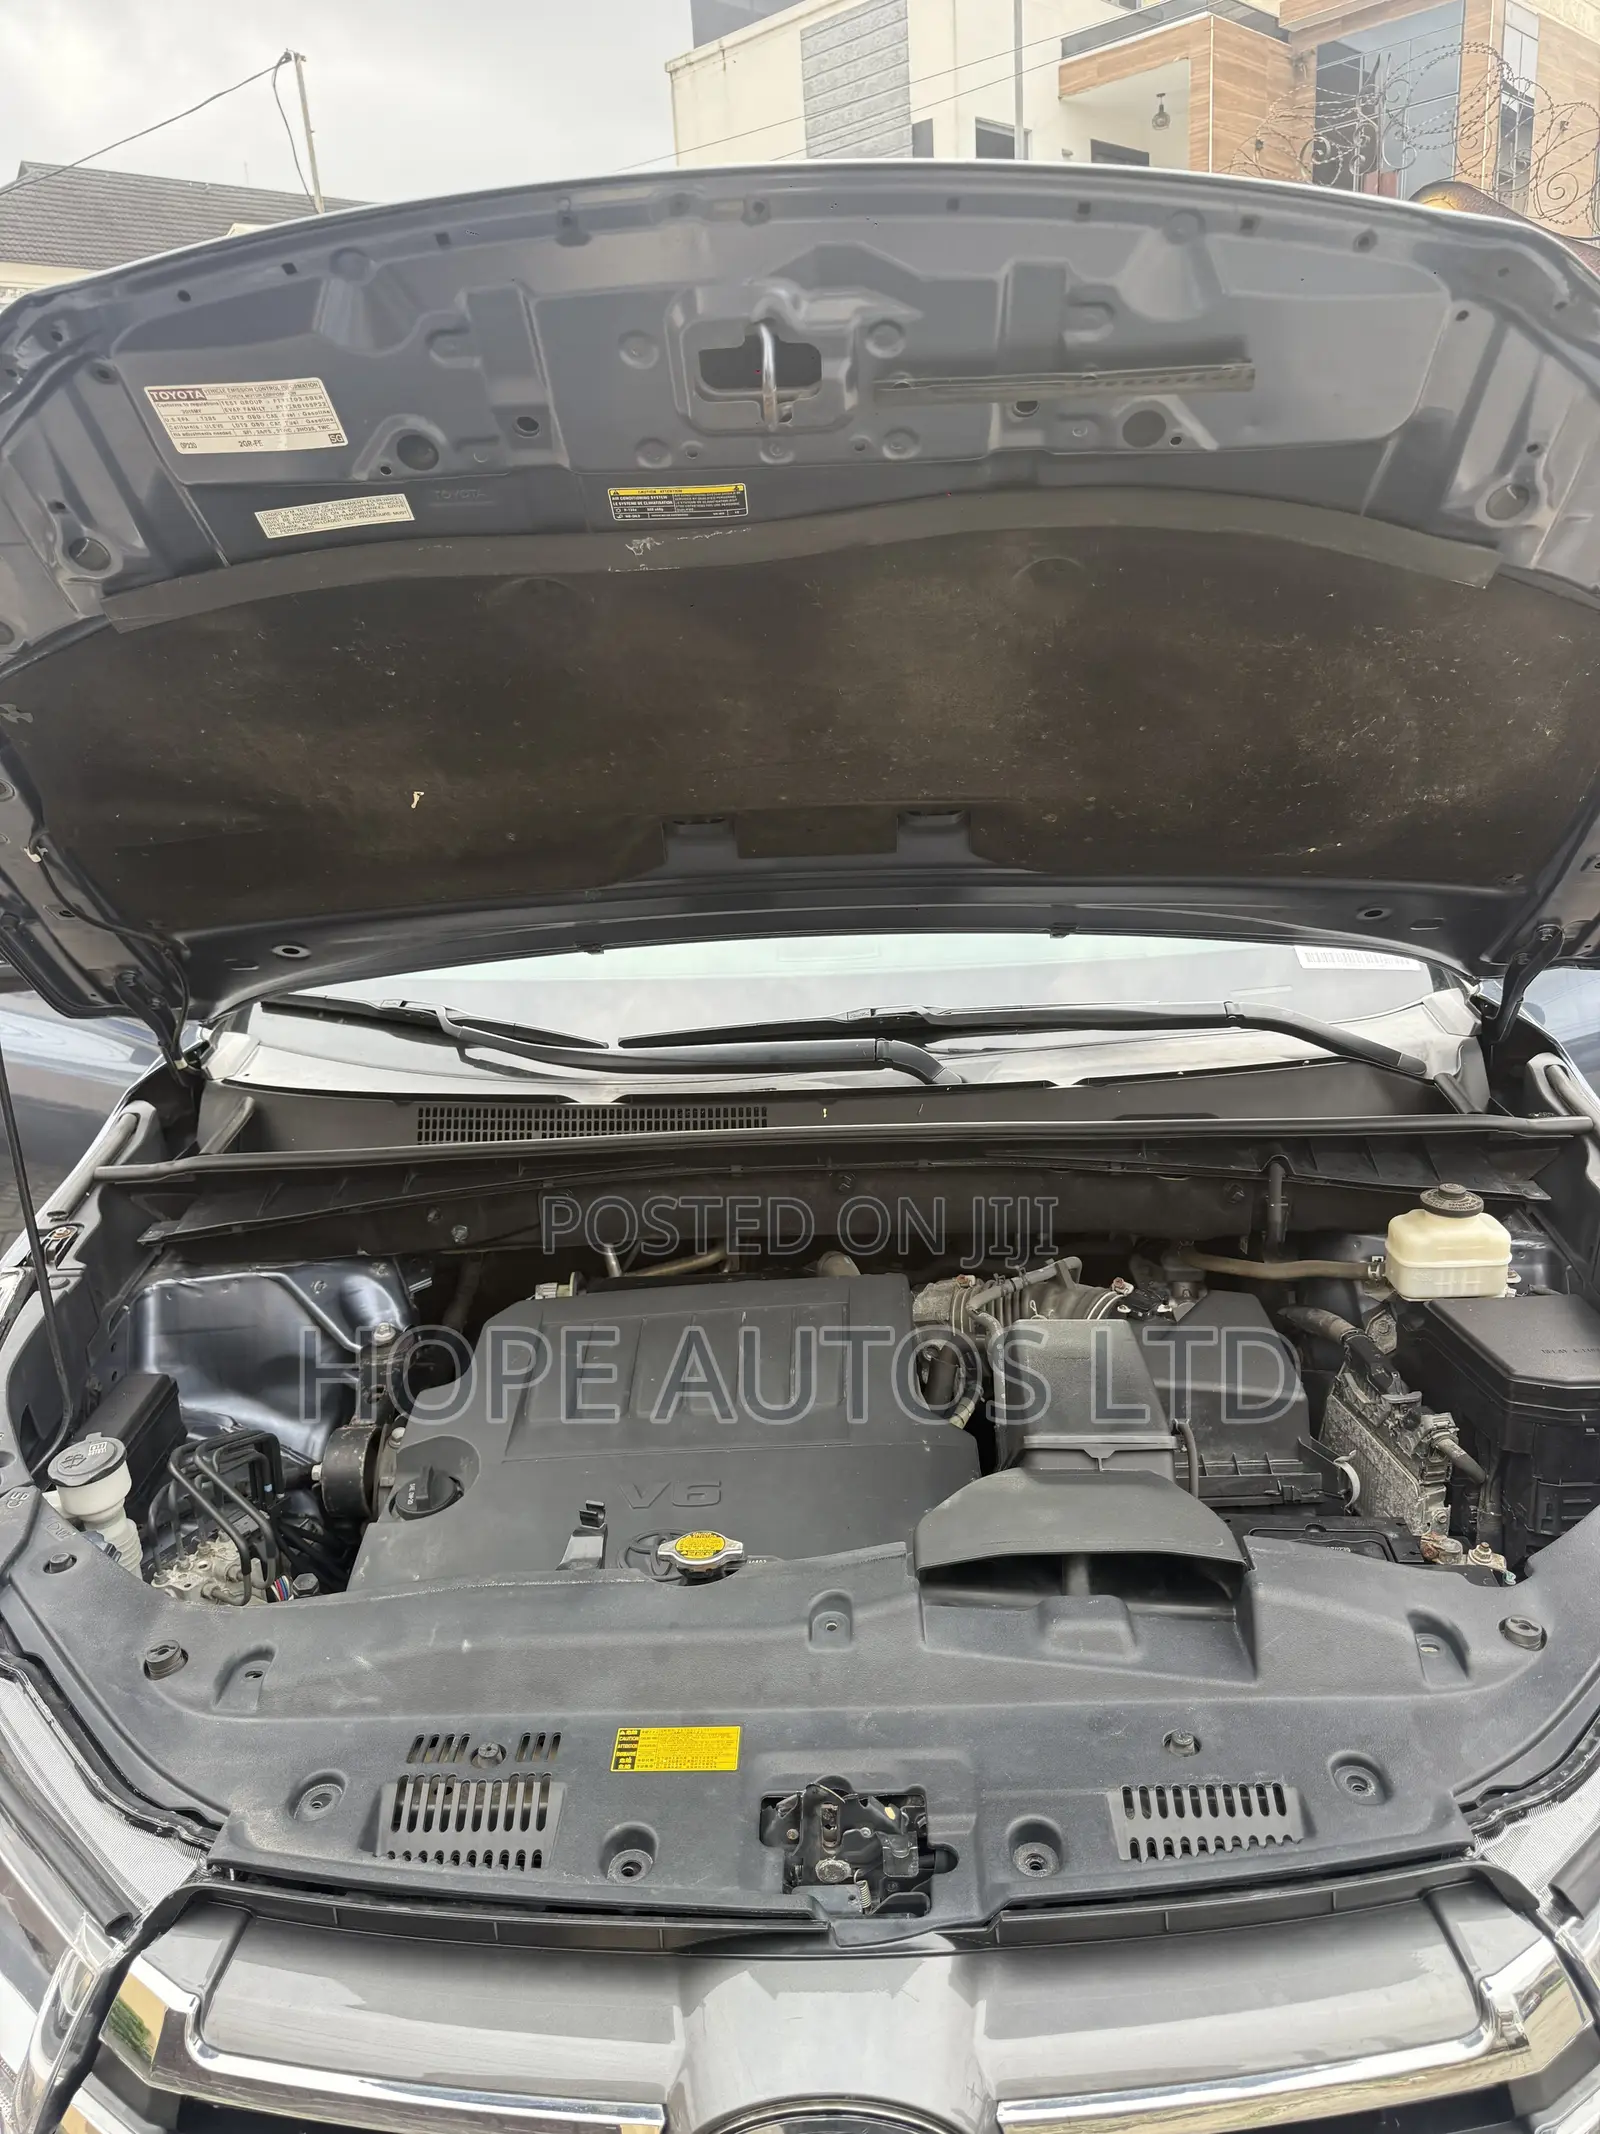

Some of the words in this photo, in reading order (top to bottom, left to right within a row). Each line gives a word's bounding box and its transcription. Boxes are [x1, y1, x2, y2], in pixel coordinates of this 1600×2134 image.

[150, 389, 204, 400] TOYOTA
[330, 434, 344, 442] SG
[616, 1480, 723, 1510] V6
